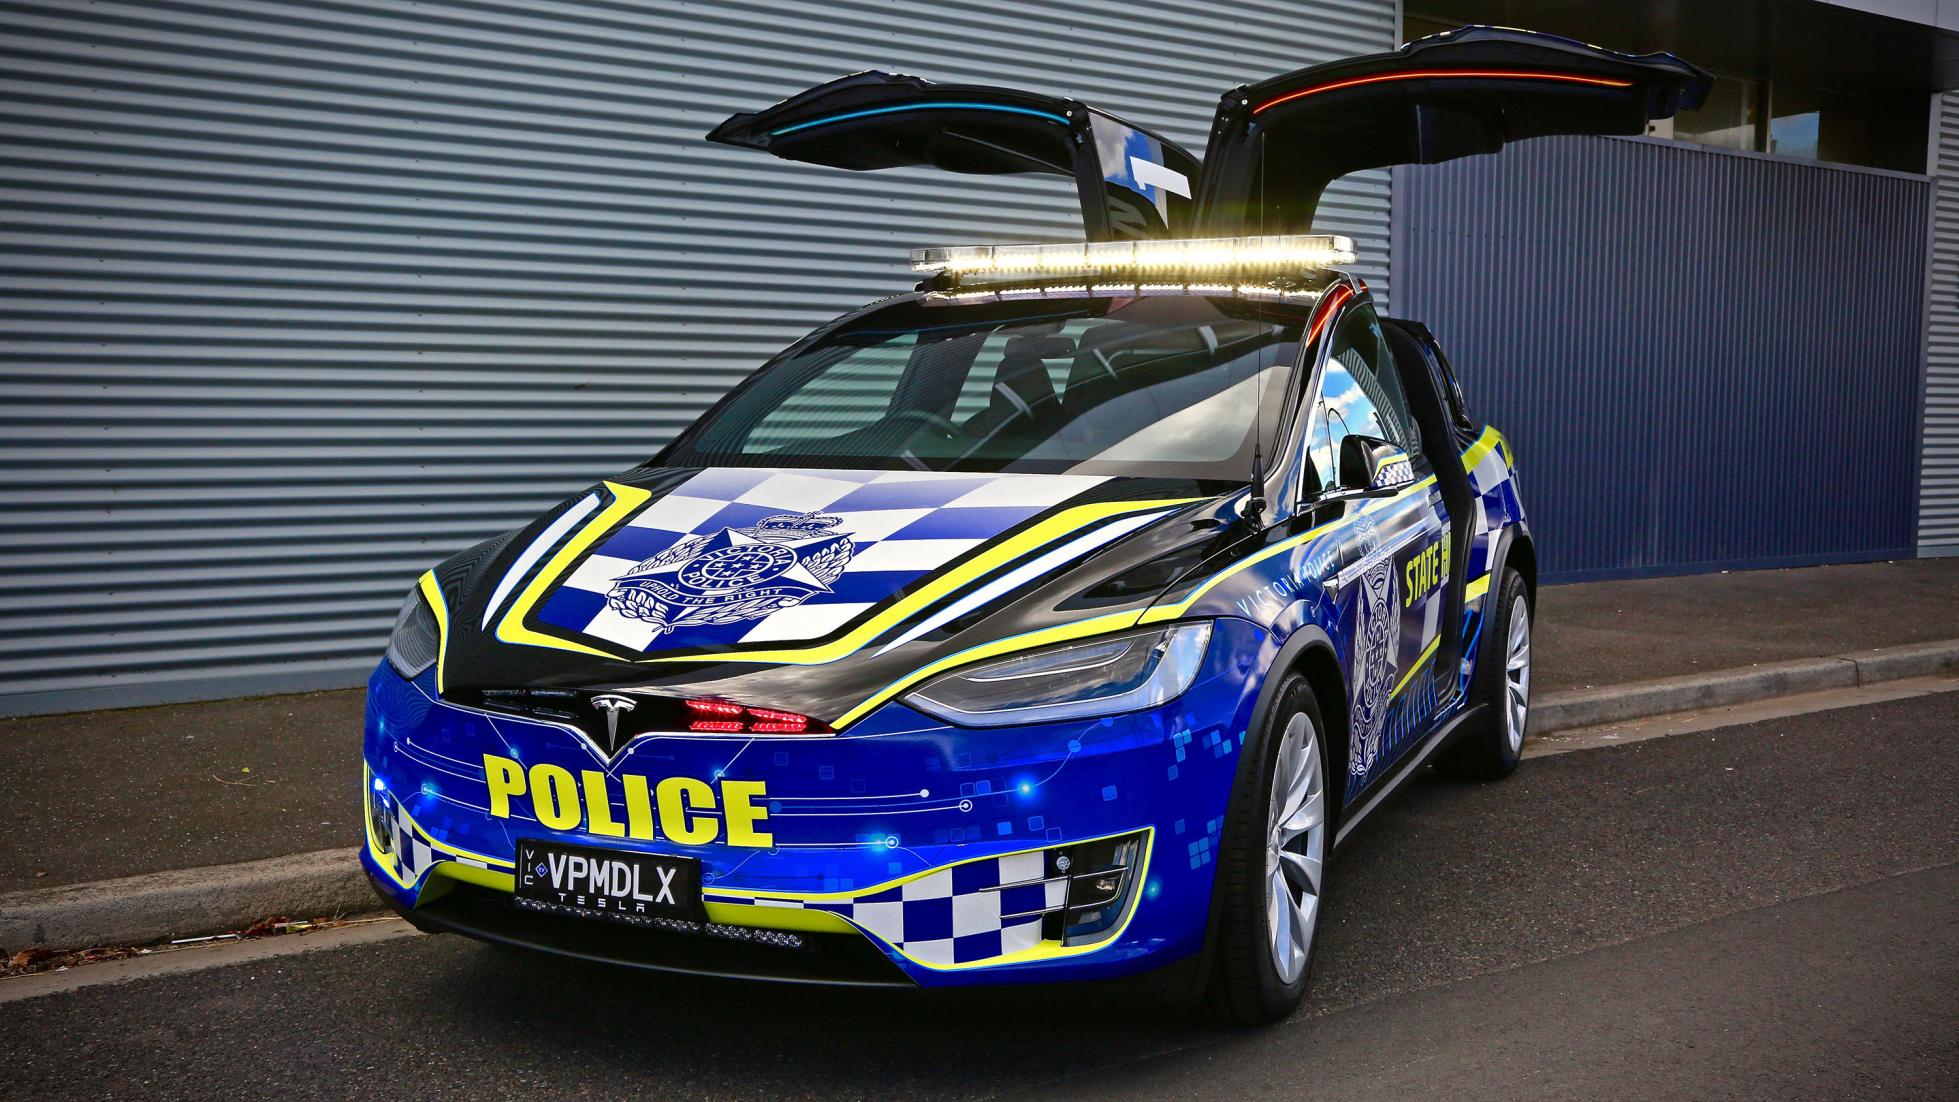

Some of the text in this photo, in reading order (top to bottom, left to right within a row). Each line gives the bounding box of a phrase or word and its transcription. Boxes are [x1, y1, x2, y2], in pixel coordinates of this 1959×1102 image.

[700, 545, 793, 566] VICTORIA
[639, 580, 783, 604] UPHOLD THE RIGHT
[682, 571, 764, 588] POLICE
[1236, 550, 1335, 617] VICTORIA POLICE
[1406, 541, 1439, 608] STATE
[482, 753, 773, 848] POLICE
[524, 849, 535, 885] VIC
[547, 852, 677, 905] VPMDLX
[558, 892, 645, 913] TESLA
